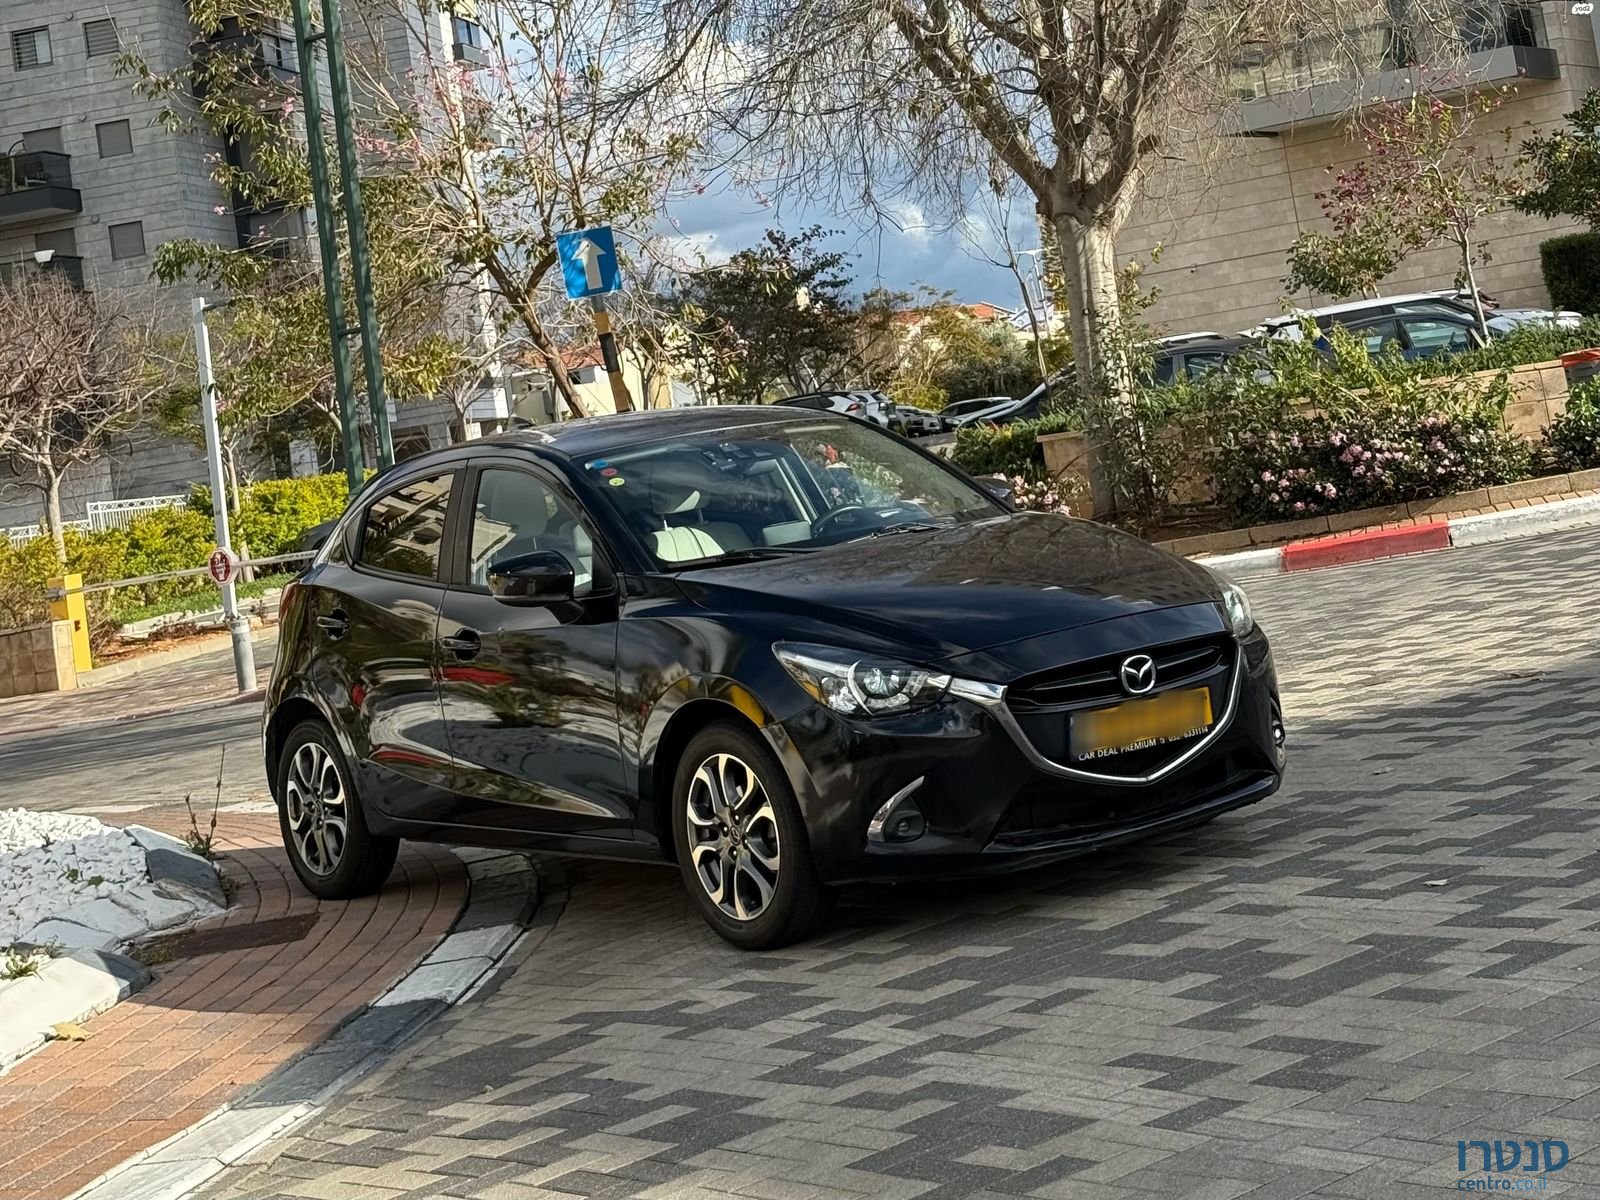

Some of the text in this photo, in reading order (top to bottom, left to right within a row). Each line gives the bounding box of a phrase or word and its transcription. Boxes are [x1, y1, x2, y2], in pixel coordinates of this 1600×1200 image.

[1078, 750, 1096, 761] CAR
[1097, 746, 1119, 758] DEAL
[1120, 738, 1157, 754] PREMIUM
